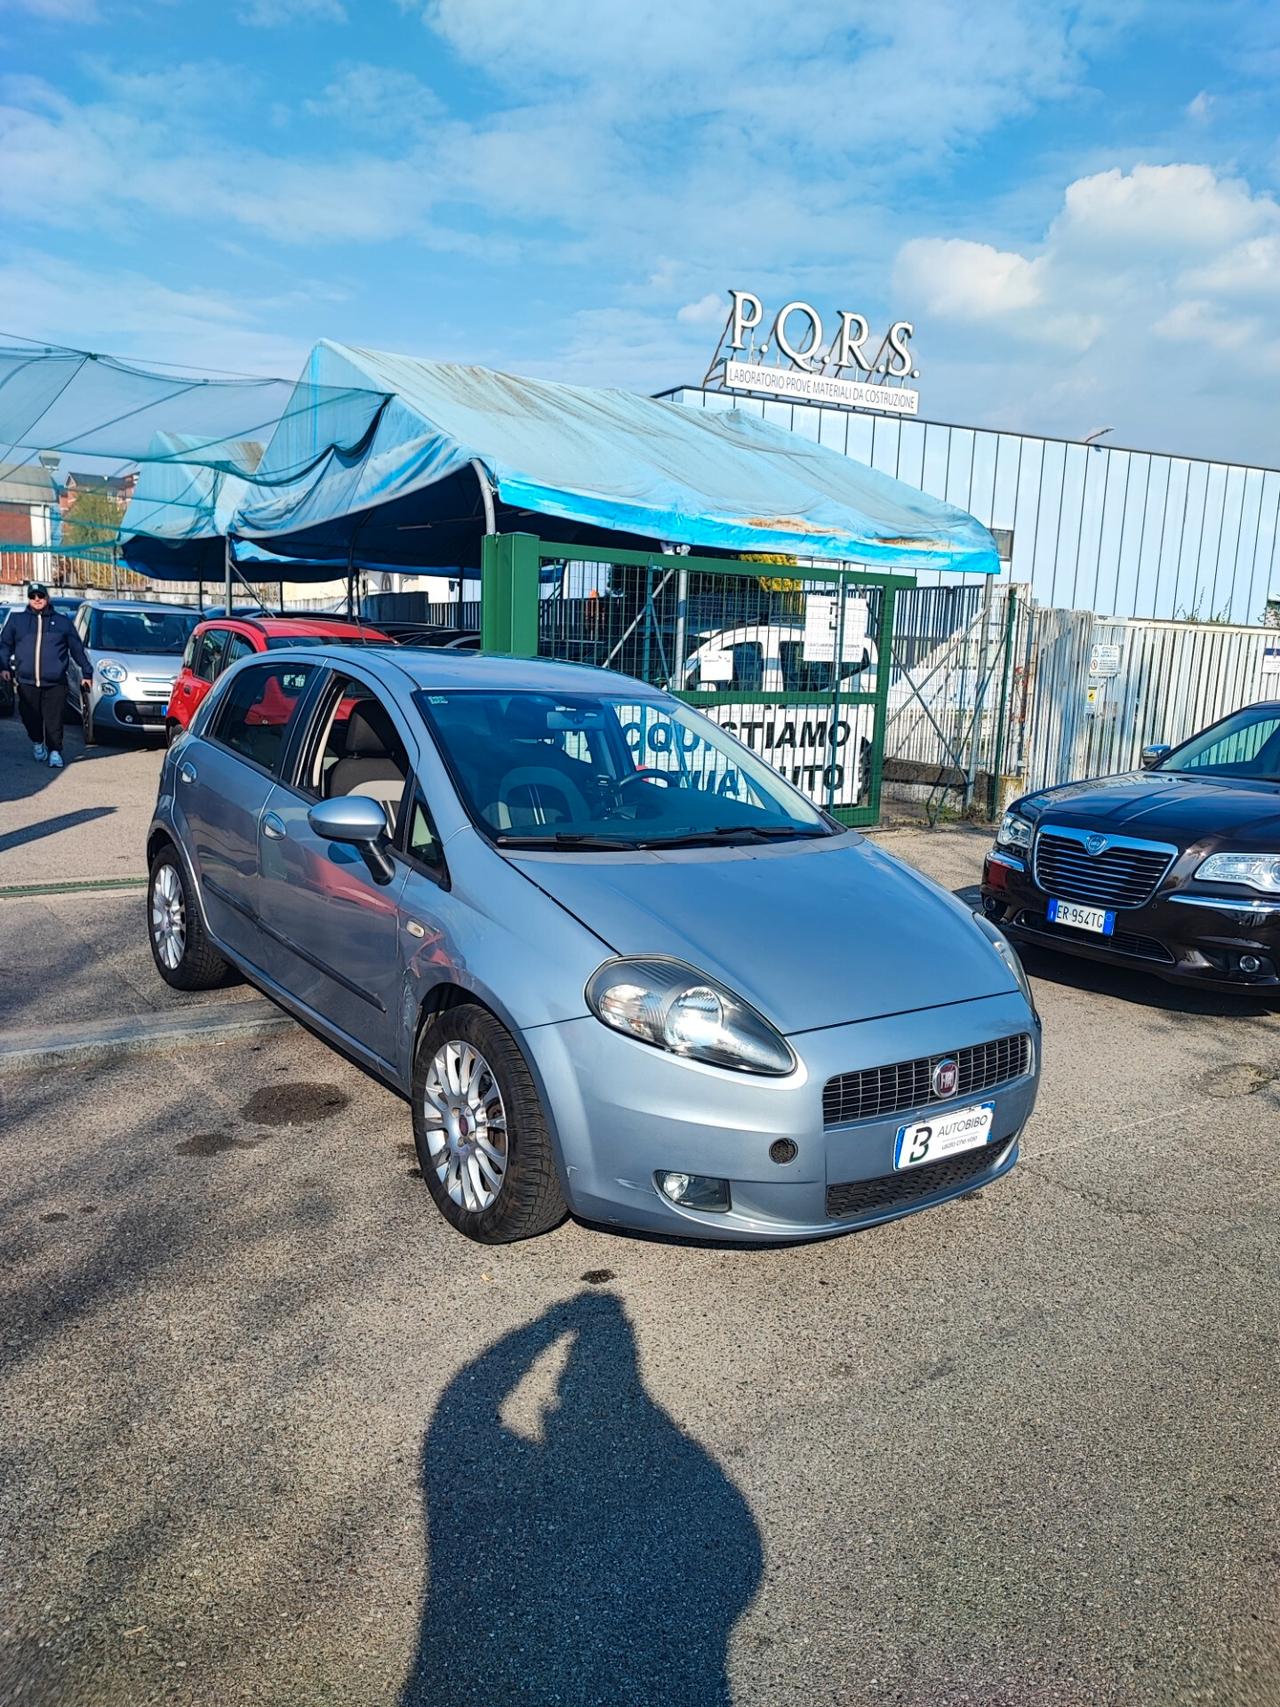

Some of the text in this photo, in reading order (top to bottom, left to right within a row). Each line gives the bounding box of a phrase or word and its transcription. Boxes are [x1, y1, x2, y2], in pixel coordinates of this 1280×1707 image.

[726, 290, 920, 378] P.Q.R.S.
[729, 368, 915, 409] LABORATORIO PROVE MATERIALI DA COSTRUZIONE
[937, 1114, 988, 1137] AUTOBIBO
